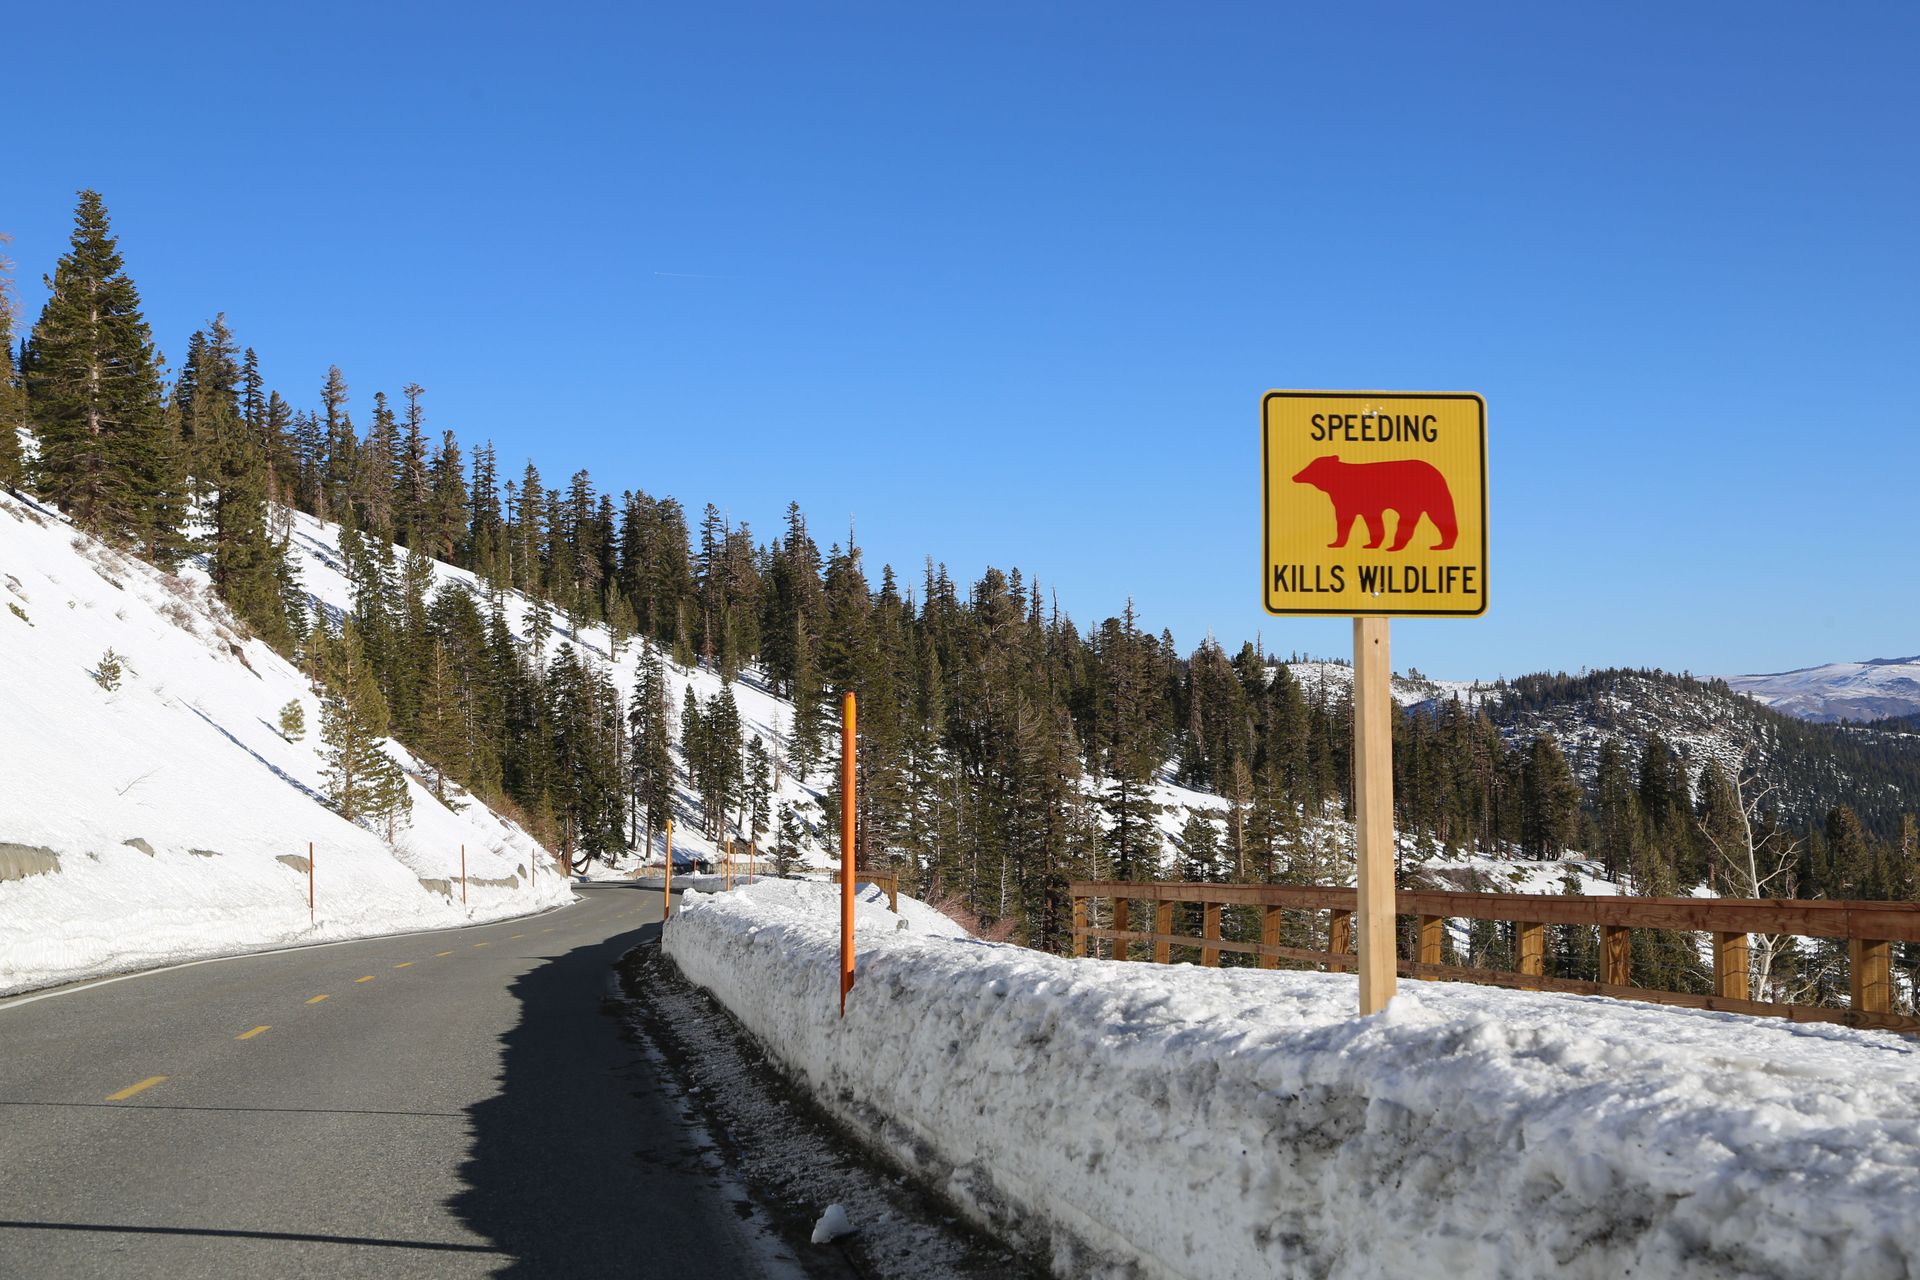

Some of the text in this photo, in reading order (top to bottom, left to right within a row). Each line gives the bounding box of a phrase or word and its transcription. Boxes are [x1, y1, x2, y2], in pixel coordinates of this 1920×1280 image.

[1310, 414, 1438, 443] SPEEDING
[1274, 565, 1477, 594] KILLS WILDLIFE
